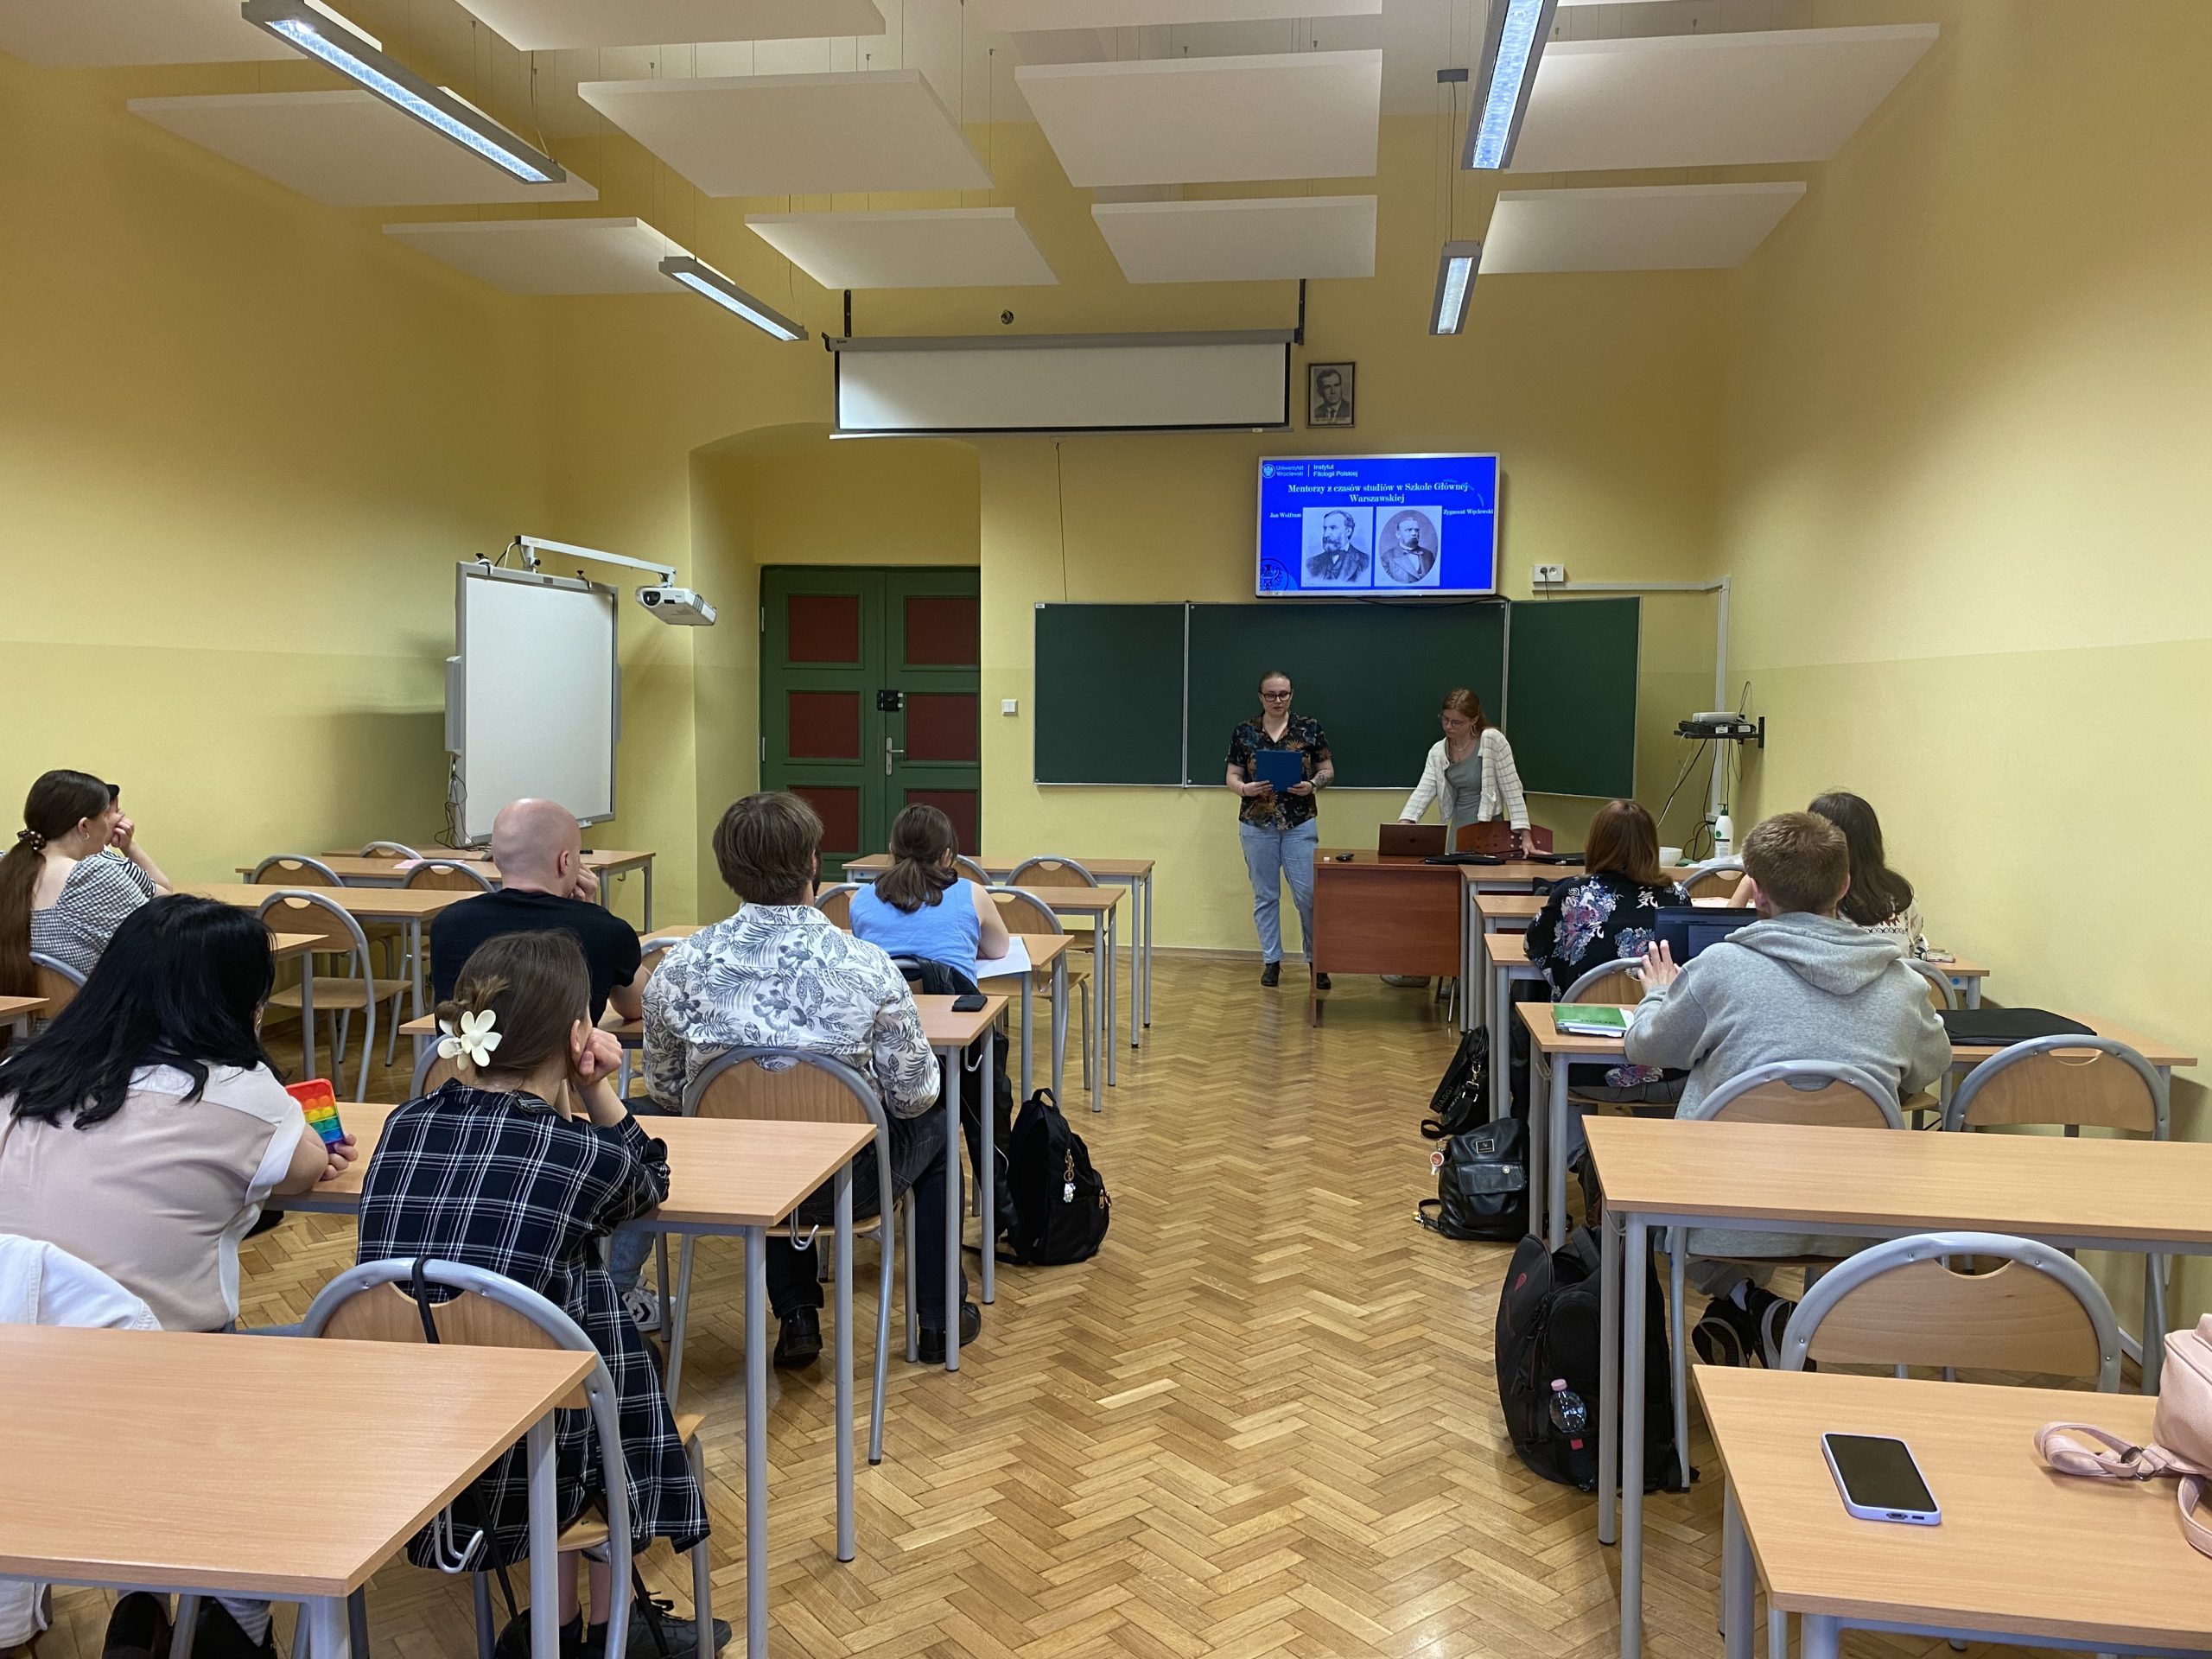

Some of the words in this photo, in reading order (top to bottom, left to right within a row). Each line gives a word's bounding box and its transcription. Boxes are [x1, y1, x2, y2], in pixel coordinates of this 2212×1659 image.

[1287, 484, 1325, 494] Mentorzy
[1333, 484, 1361, 493] czasów
[1363, 483, 1395, 492] studiów
[1404, 482, 1433, 491] Szkole
[1433, 481, 1468, 493] Głównej
[1350, 493, 1405, 503] Warszawskiej
